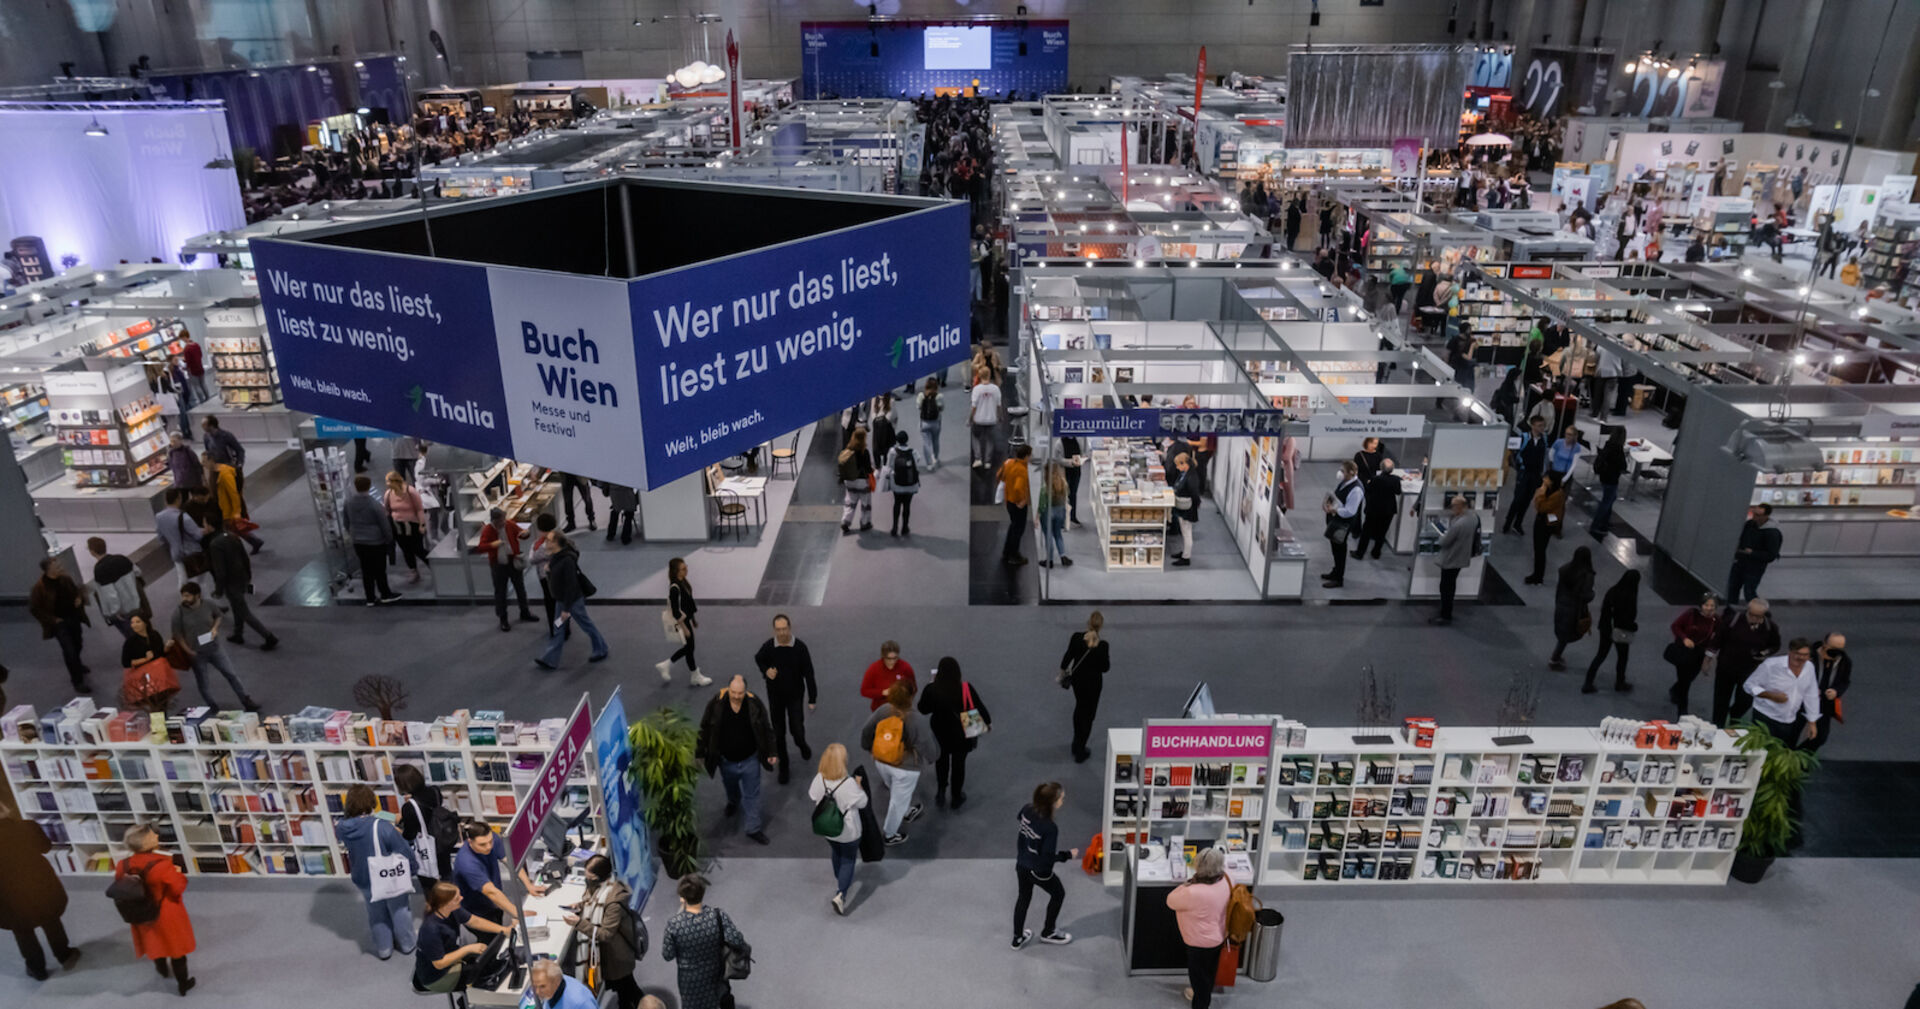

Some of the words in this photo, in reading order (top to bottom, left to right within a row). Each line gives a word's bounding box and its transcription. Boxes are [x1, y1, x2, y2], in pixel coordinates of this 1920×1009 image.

[267, 269, 308, 299] Wer
[313, 282, 344, 304] nur
[350, 281, 385, 311] das
[388, 285, 442, 325] liest,
[653, 301, 723, 348] Wer
[732, 288, 781, 327] nur
[788, 270, 834, 310] das
[841, 252, 898, 294] liest,
[277, 308, 318, 339] liest
[320, 322, 343, 344] zu
[347, 326, 415, 361] wenig.
[521, 320, 600, 364] Buch
[905, 324, 961, 362] Thalia
[660, 352, 727, 405] liest
[735, 345, 768, 380] zu
[775, 311, 862, 365] wenig.
[290, 374, 316, 393] Welt,
[316, 379, 341, 397] bleib
[343, 387, 373, 403] wach.
[536, 362, 618, 408] Wien
[425, 392, 496, 430] Thalia
[532, 400, 566, 418] Messe
[569, 410, 591, 423] und
[534, 418, 576, 438] Festival
[1060, 416, 1146, 430] braumüller
[1367, 418, 1388, 426] Verlag
[665, 435, 698, 457] Welt,
[700, 422, 730, 445] bleib
[731, 409, 765, 432] wach.
[1151, 735, 1265, 748] BUCHHANDLUNG
[526, 735, 577, 833] KASSA
[379, 861, 406, 878] oag
